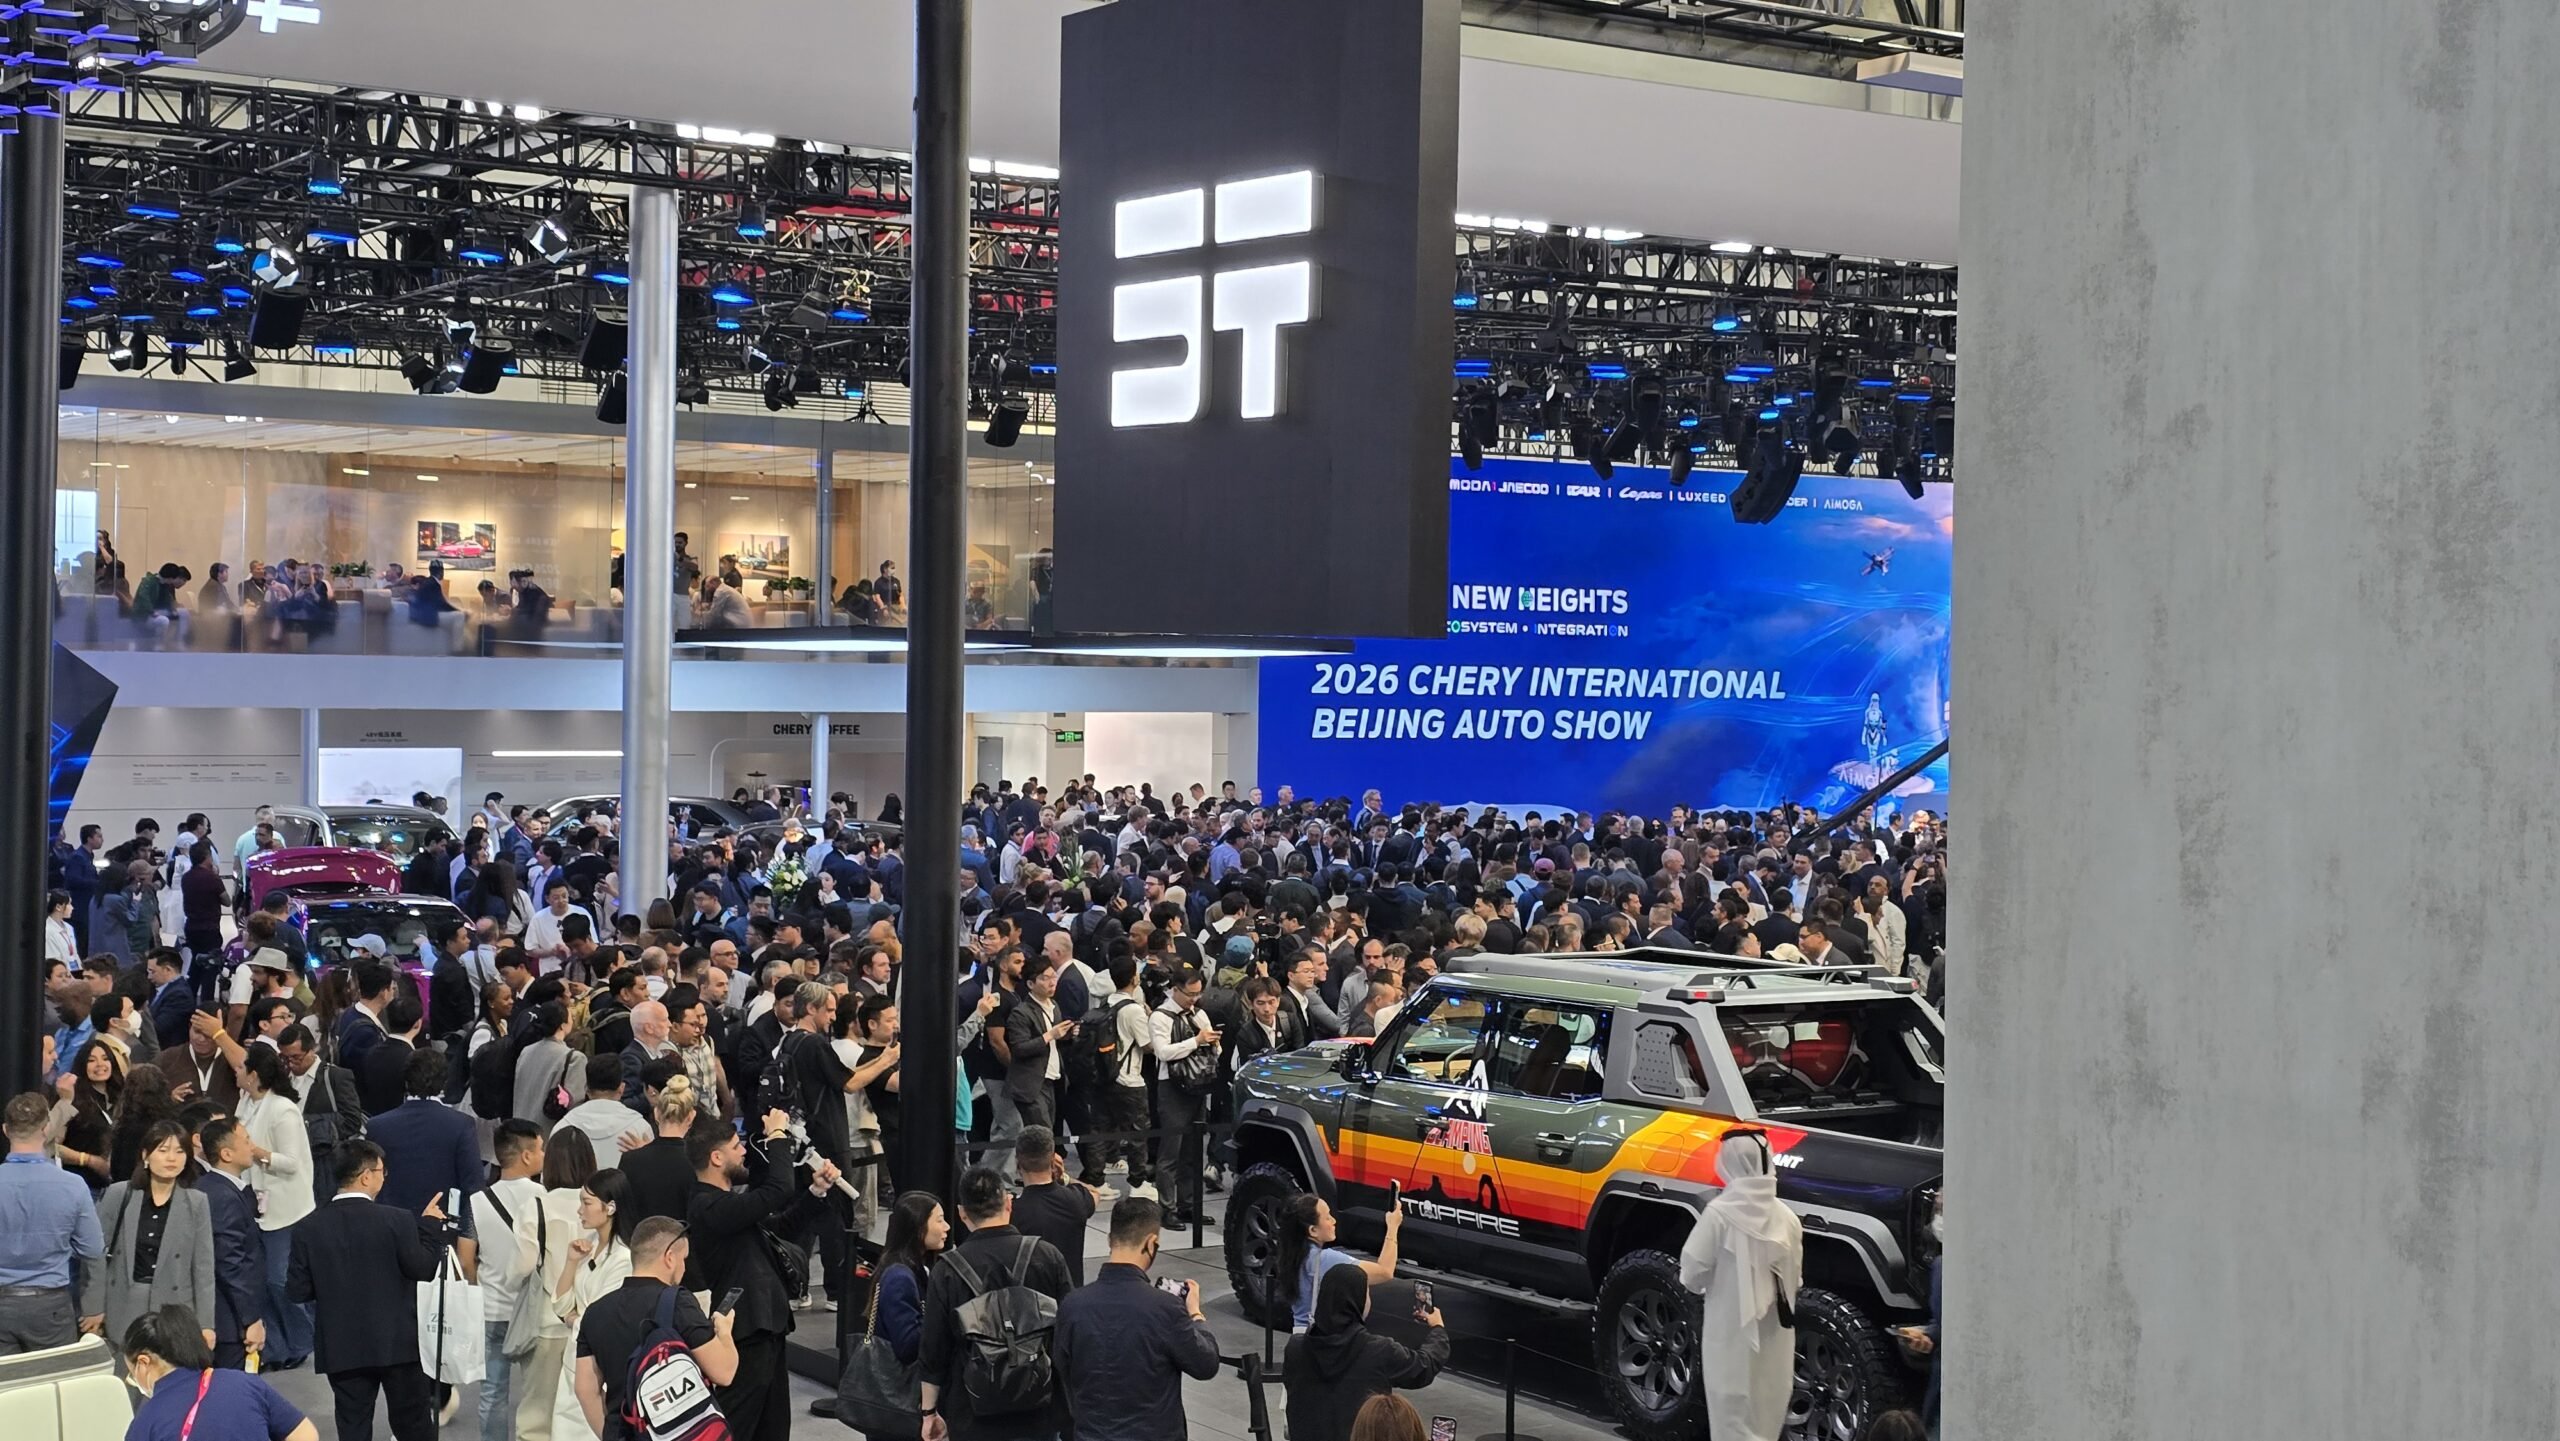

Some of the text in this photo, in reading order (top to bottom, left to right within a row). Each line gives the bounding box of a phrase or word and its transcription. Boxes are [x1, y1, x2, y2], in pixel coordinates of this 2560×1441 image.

[1449, 478, 1491, 491] MODA
[1677, 491, 1727, 503] LUXEED
[1785, 497, 1808, 507] DER
[1452, 584, 1628, 613] NEW HEIGHTS
[1447, 620, 1628, 637] OSYSTEM INTEGRATION
[1311, 663, 1786, 699] 2026 CHERY INTERNATIONAL
[773, 724, 812, 735] CHERY
[1311, 708, 1653, 740] BEIJING AUTO SHOW
[1772, 1153, 1804, 1169] ANT
[1400, 1196, 1521, 1238] TOPFIRE
[649, 1377, 696, 1411] FILA
